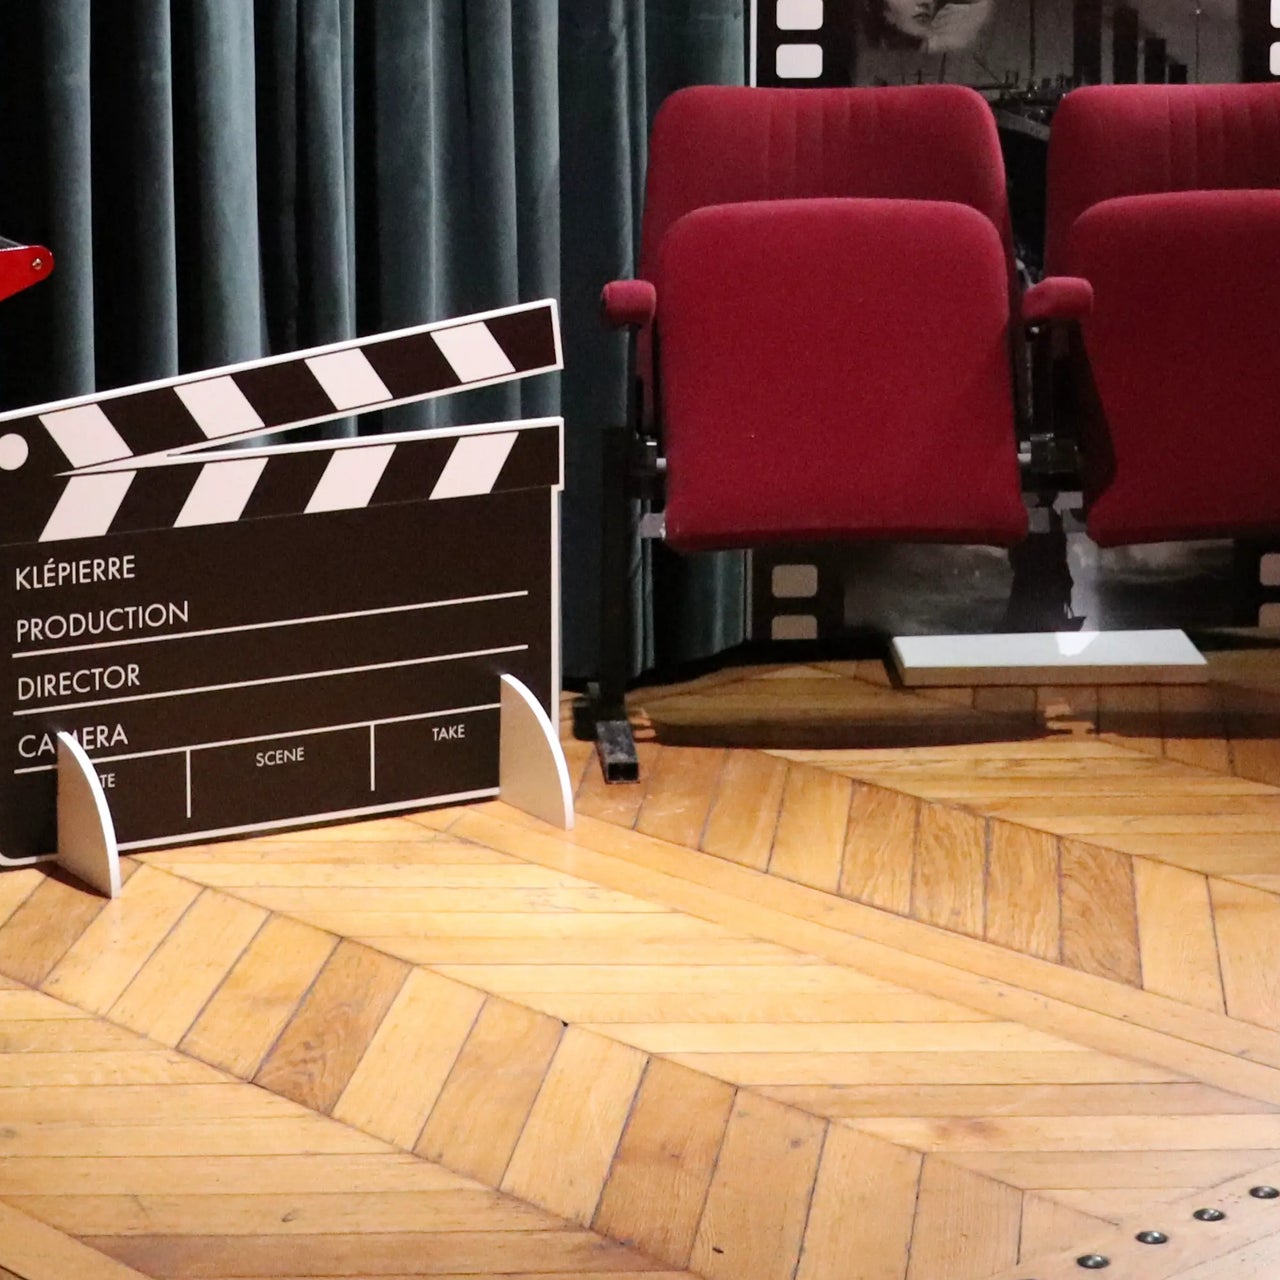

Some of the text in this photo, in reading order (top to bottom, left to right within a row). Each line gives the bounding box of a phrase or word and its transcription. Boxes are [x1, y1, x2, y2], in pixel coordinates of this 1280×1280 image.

[15, 555, 136, 591] KLÉPIERRE
[16, 600, 188, 643] PRODUCTION
[18, 664, 140, 701] DIRECTOR
[18, 723, 129, 758] CAERA
[432, 724, 466, 741] TAKE
[255, 747, 305, 767] SCENE
